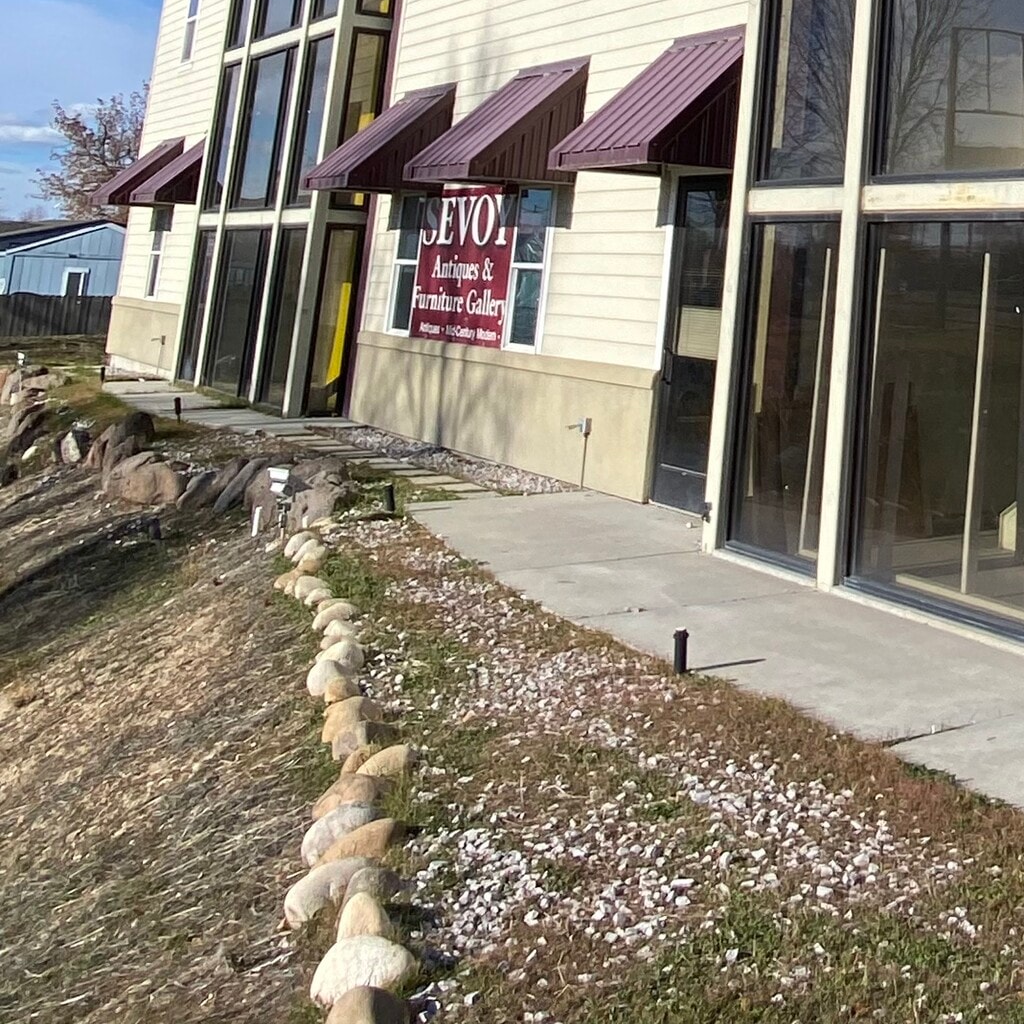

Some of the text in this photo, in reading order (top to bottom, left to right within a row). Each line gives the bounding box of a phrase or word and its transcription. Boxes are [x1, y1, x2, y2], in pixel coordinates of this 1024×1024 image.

[422, 194, 515, 246] SEVOY
[431, 255, 494, 287] Antiques &
[413, 285, 507, 325] Furniture Gallery
